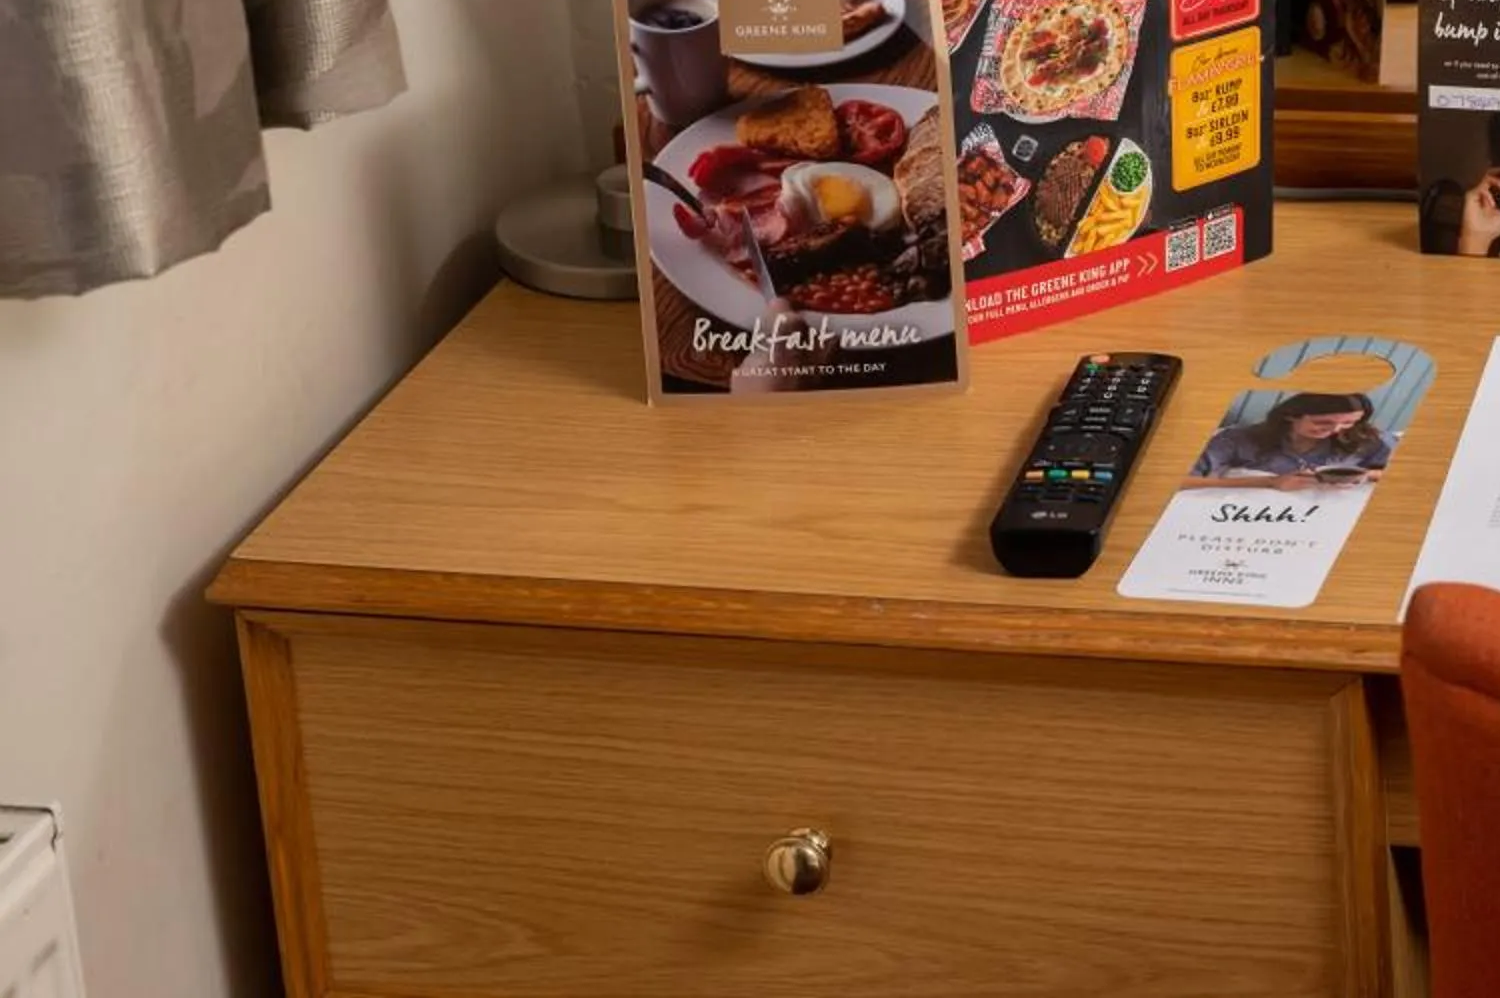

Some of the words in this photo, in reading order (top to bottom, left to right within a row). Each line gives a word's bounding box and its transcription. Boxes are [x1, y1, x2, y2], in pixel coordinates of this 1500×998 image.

[735, 24, 789, 38] GREENE
[792, 24, 827, 37] KING
[1434, 12, 1488, 46] bump
[1005, 284, 1029, 303] THE
[1031, 273, 1077, 297] GREENE
[1079, 264, 1107, 284] KING
[1109, 257, 1131, 275] APP
[692, 313, 837, 364] Breakfast
[839, 323, 922, 350] menu
[781, 365, 815, 376] START
[817, 365, 835, 375] TO
[838, 363, 860, 373] THE
[863, 362, 887, 373] DAY
[1211, 503, 1319, 522] Shhh!
[1178, 534, 1244, 544] PLEASE
